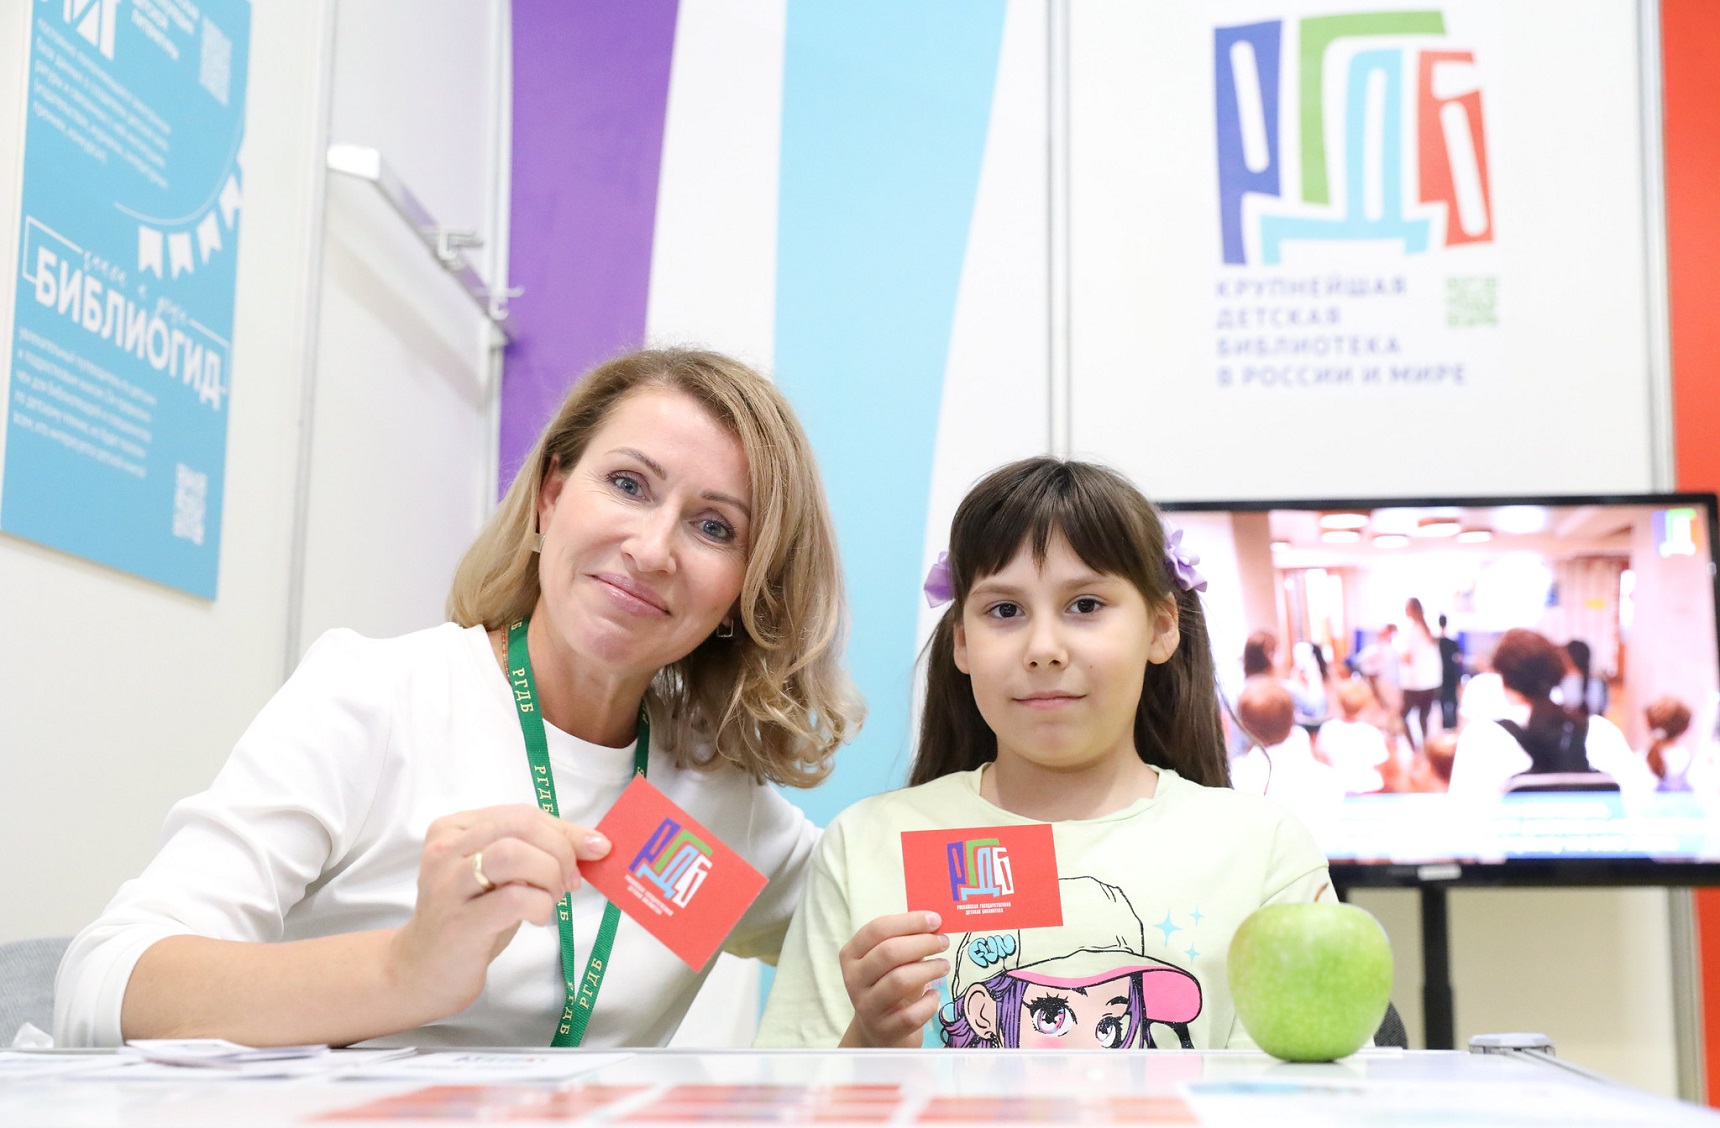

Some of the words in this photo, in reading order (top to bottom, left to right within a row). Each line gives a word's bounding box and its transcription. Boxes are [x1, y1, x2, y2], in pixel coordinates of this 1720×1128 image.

[1214, 10, 1493, 266] РГДБ
[1216, 274, 1406, 297] КРУПНЕЙШАЯ
[35, 245, 221, 412] БИБЛИОГИД
[1216, 306, 1341, 329] ДЕТСКАЯ
[1217, 335, 1401, 357] БИБЛИОТЕКА
[1217, 365, 1233, 388] В
[1242, 364, 1353, 387] РОССИИ
[1361, 364, 1381, 386] И
[1389, 361, 1465, 386] МИРЕ
[512, 667, 534, 713] РГДБ
[534, 765, 554, 814] РГДБ
[628, 817, 713, 909] РГДБ
[946, 838, 1015, 902] РГДБ
[968, 934, 1017, 968] FUN
[579, 957, 603, 1009] РГДБ
